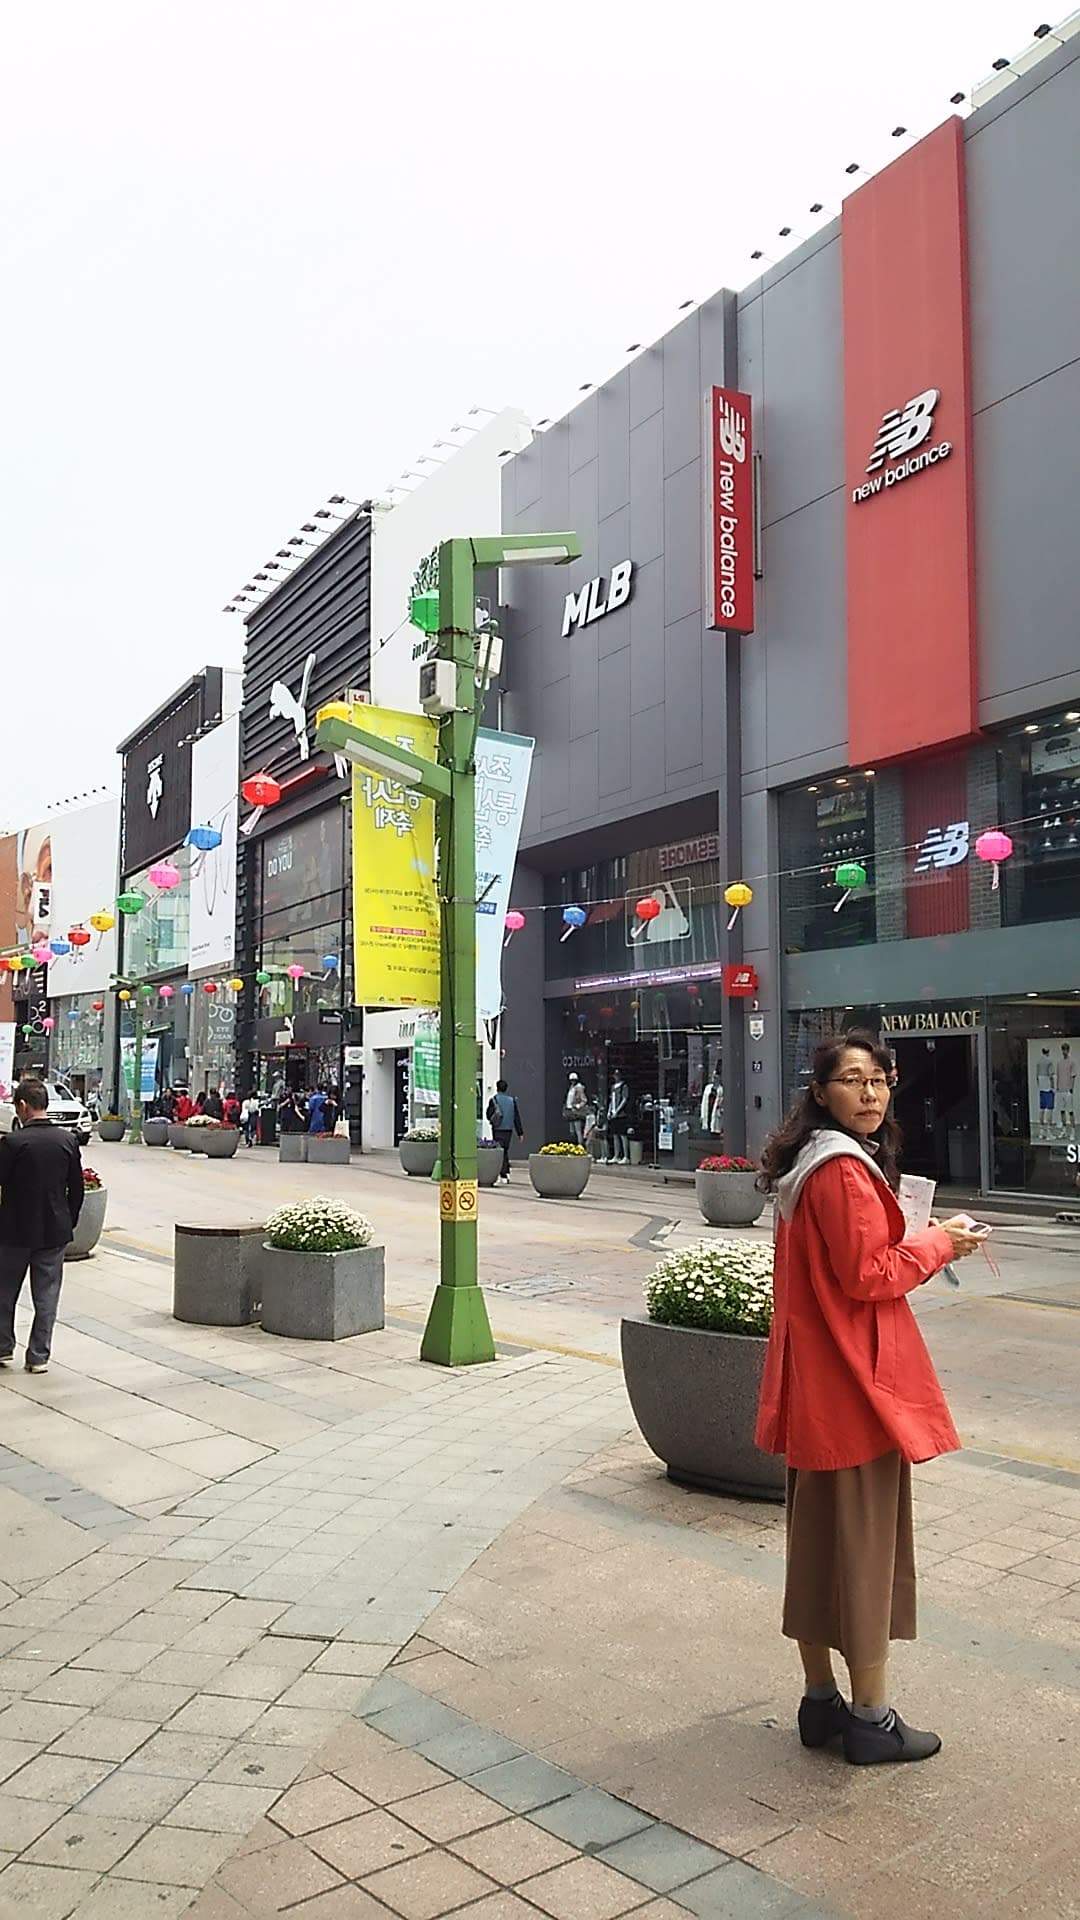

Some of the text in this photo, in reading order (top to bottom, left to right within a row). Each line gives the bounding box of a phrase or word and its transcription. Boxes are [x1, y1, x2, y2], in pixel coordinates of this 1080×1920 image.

[852, 440, 953, 505] new balance
[719, 462, 738, 619] new balance
[560, 559, 632, 638] MLB
[39, 889, 50, 918] FILA
[881, 1010, 981, 1031] NEW BALANCE
